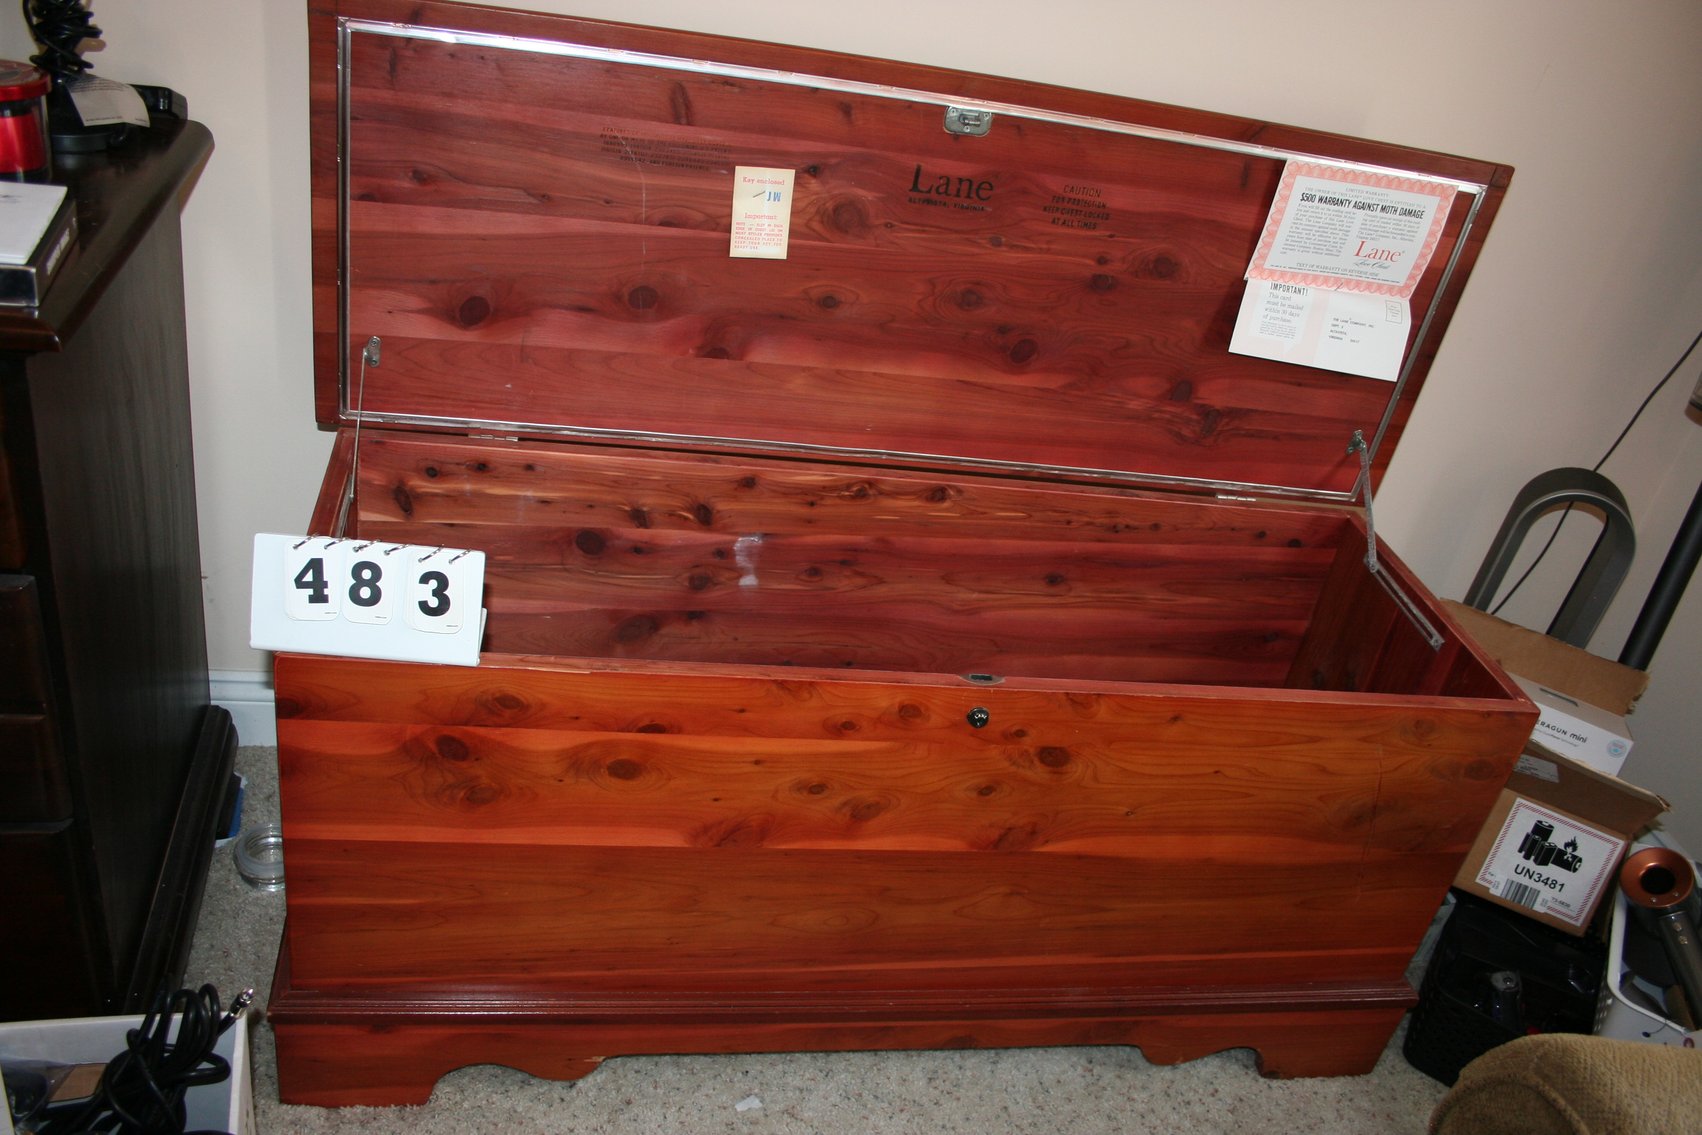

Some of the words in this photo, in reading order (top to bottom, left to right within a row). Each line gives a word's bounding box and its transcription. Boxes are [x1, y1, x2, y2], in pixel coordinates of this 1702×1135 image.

[908, 163, 994, 201] Lane
[1063, 184, 1102, 198] CAUTION
[1300, 192, 1317, 203] $500
[1316, 195, 1353, 208] WARRANTY
[1352, 200, 1380, 212] AGAINST
[1379, 204, 1399, 215] MOTH
[1398, 207, 1426, 219] DAMAGE
[1354, 240, 1401, 262] Lane
[1269, 283, 1309, 296] IMPORTANT!
[1569, 732, 1588, 743] mini
[1514, 863, 1565, 893] UN3481
